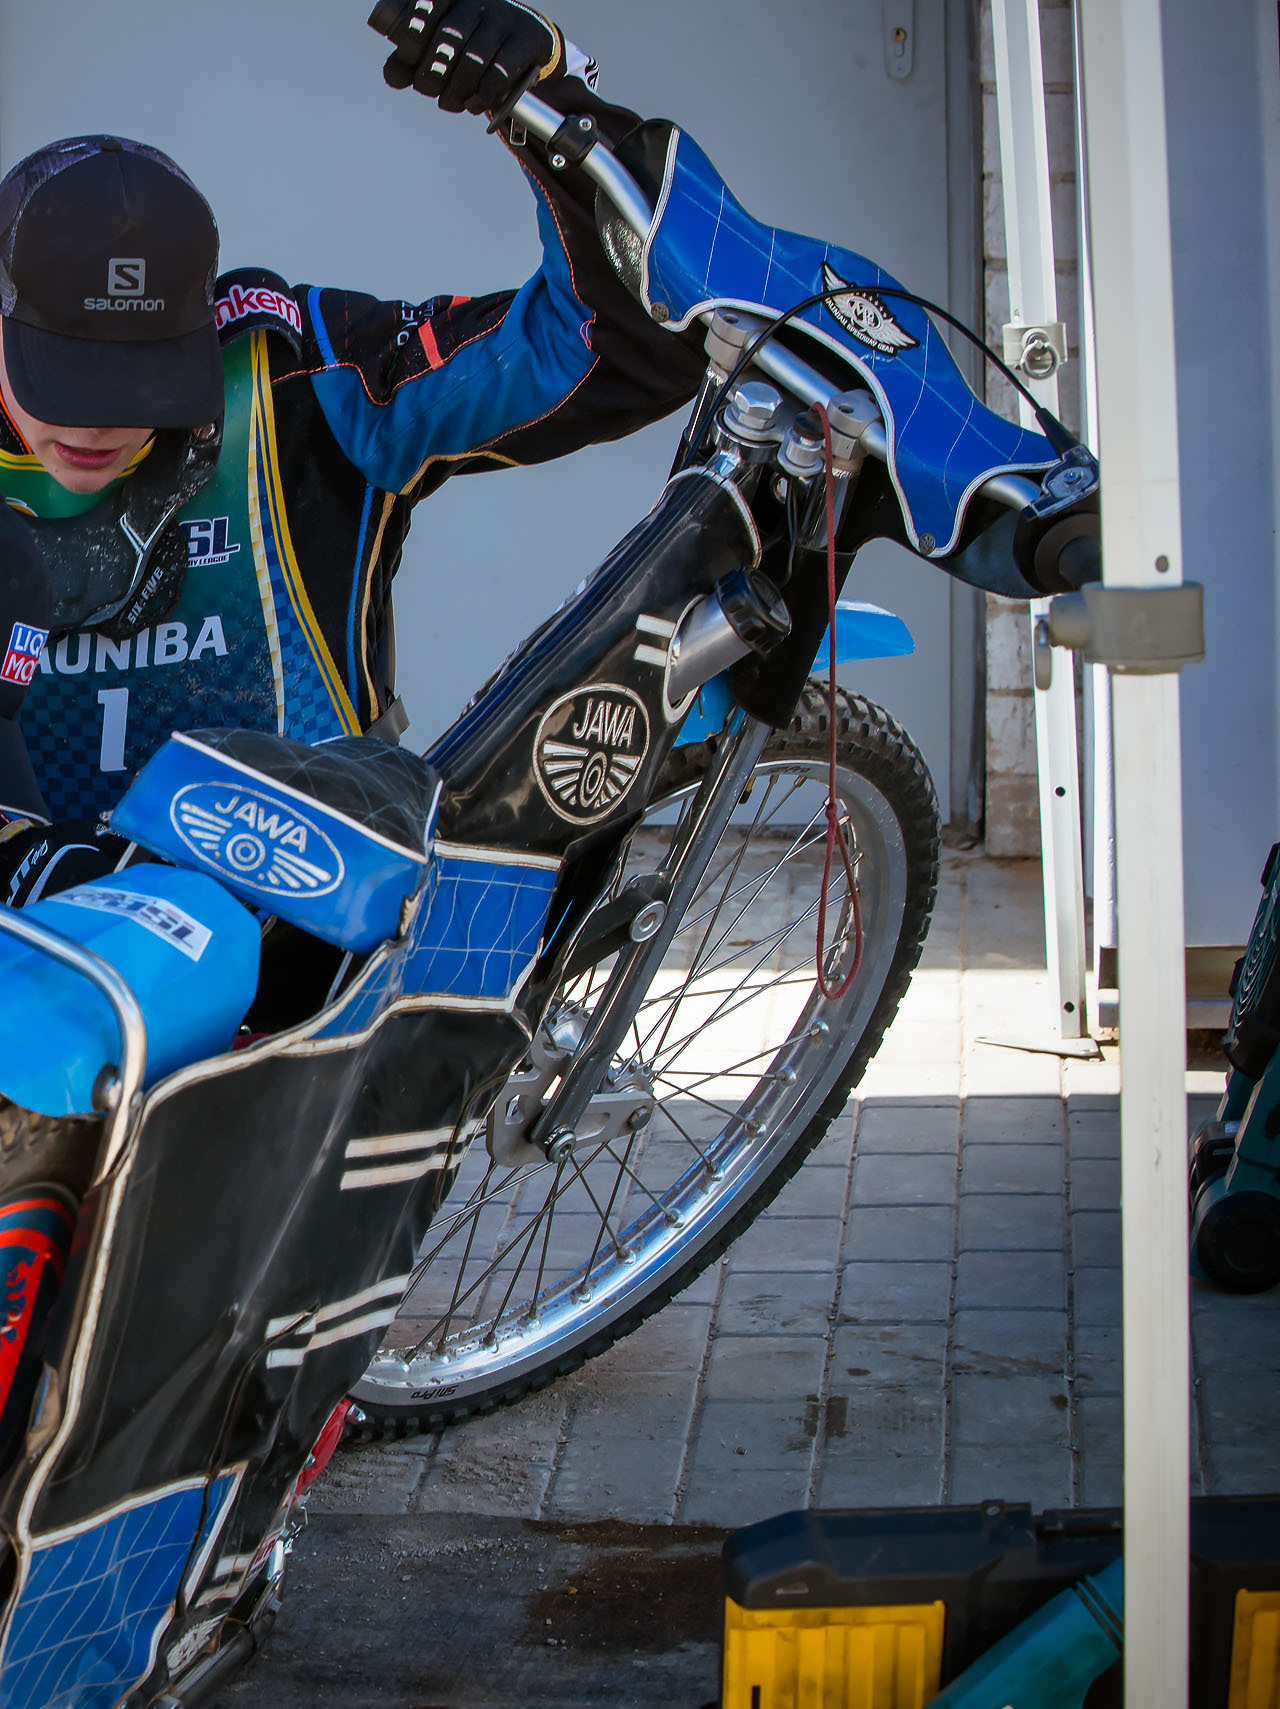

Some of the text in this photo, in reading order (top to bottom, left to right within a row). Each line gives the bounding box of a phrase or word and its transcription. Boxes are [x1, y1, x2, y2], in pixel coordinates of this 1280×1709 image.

[5, 653, 35, 682] MO
[15, 627, 47, 658] LIQ
[97, 687, 129, 772] 1
[573, 698, 637, 749] JAWA
[215, 795, 307, 853] JAWA
